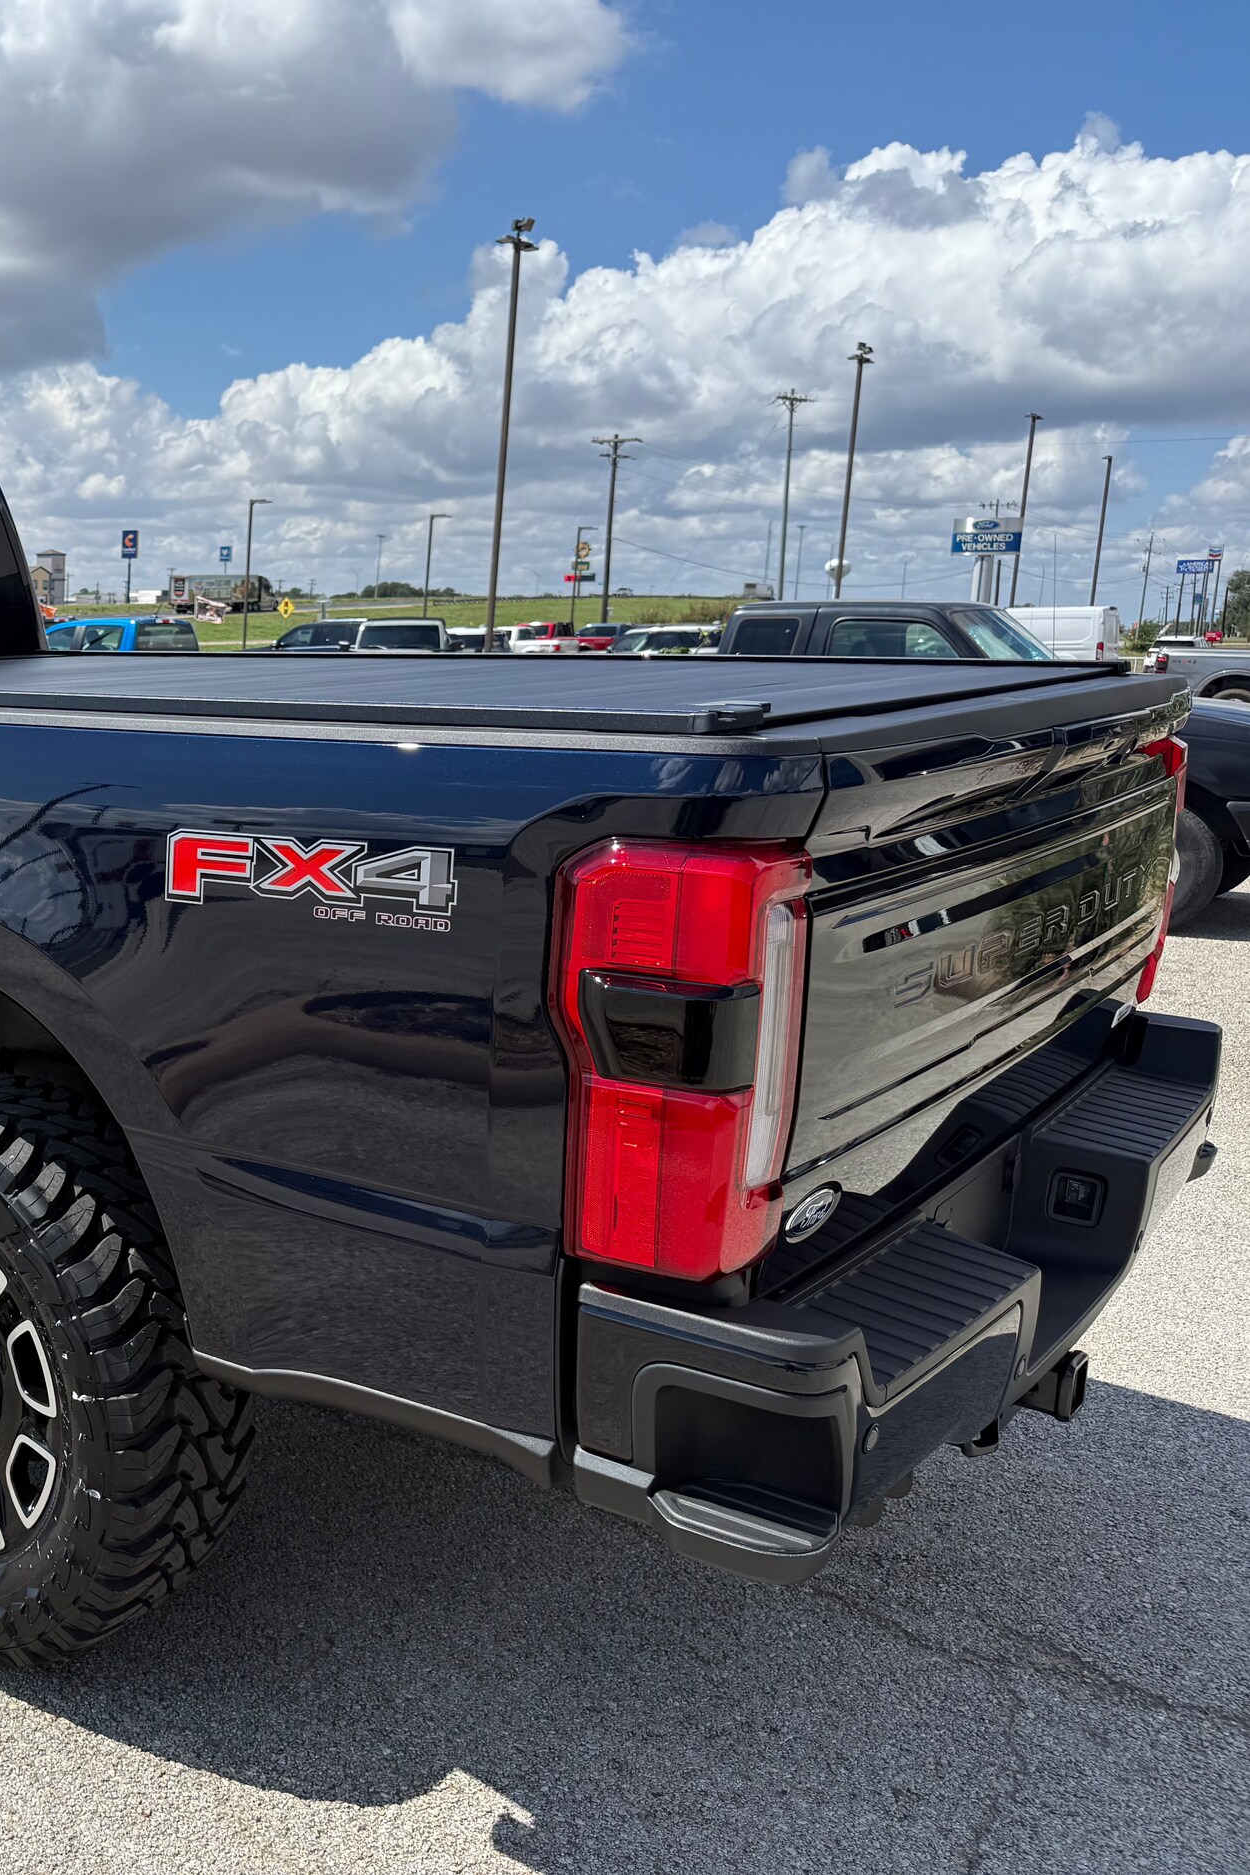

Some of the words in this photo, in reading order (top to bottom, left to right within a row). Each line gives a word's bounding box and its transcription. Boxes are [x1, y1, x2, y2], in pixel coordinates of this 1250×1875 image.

[976, 521, 995, 529] Ford
[961, 543, 1006, 551] VEHICLES
[164, 828, 458, 916] FX4
[313, 905, 366, 922] OFF
[375, 911, 451, 932] ROAD
[893, 904, 1070, 1009] SUPER
[1076, 863, 1155, 926] DUTY
